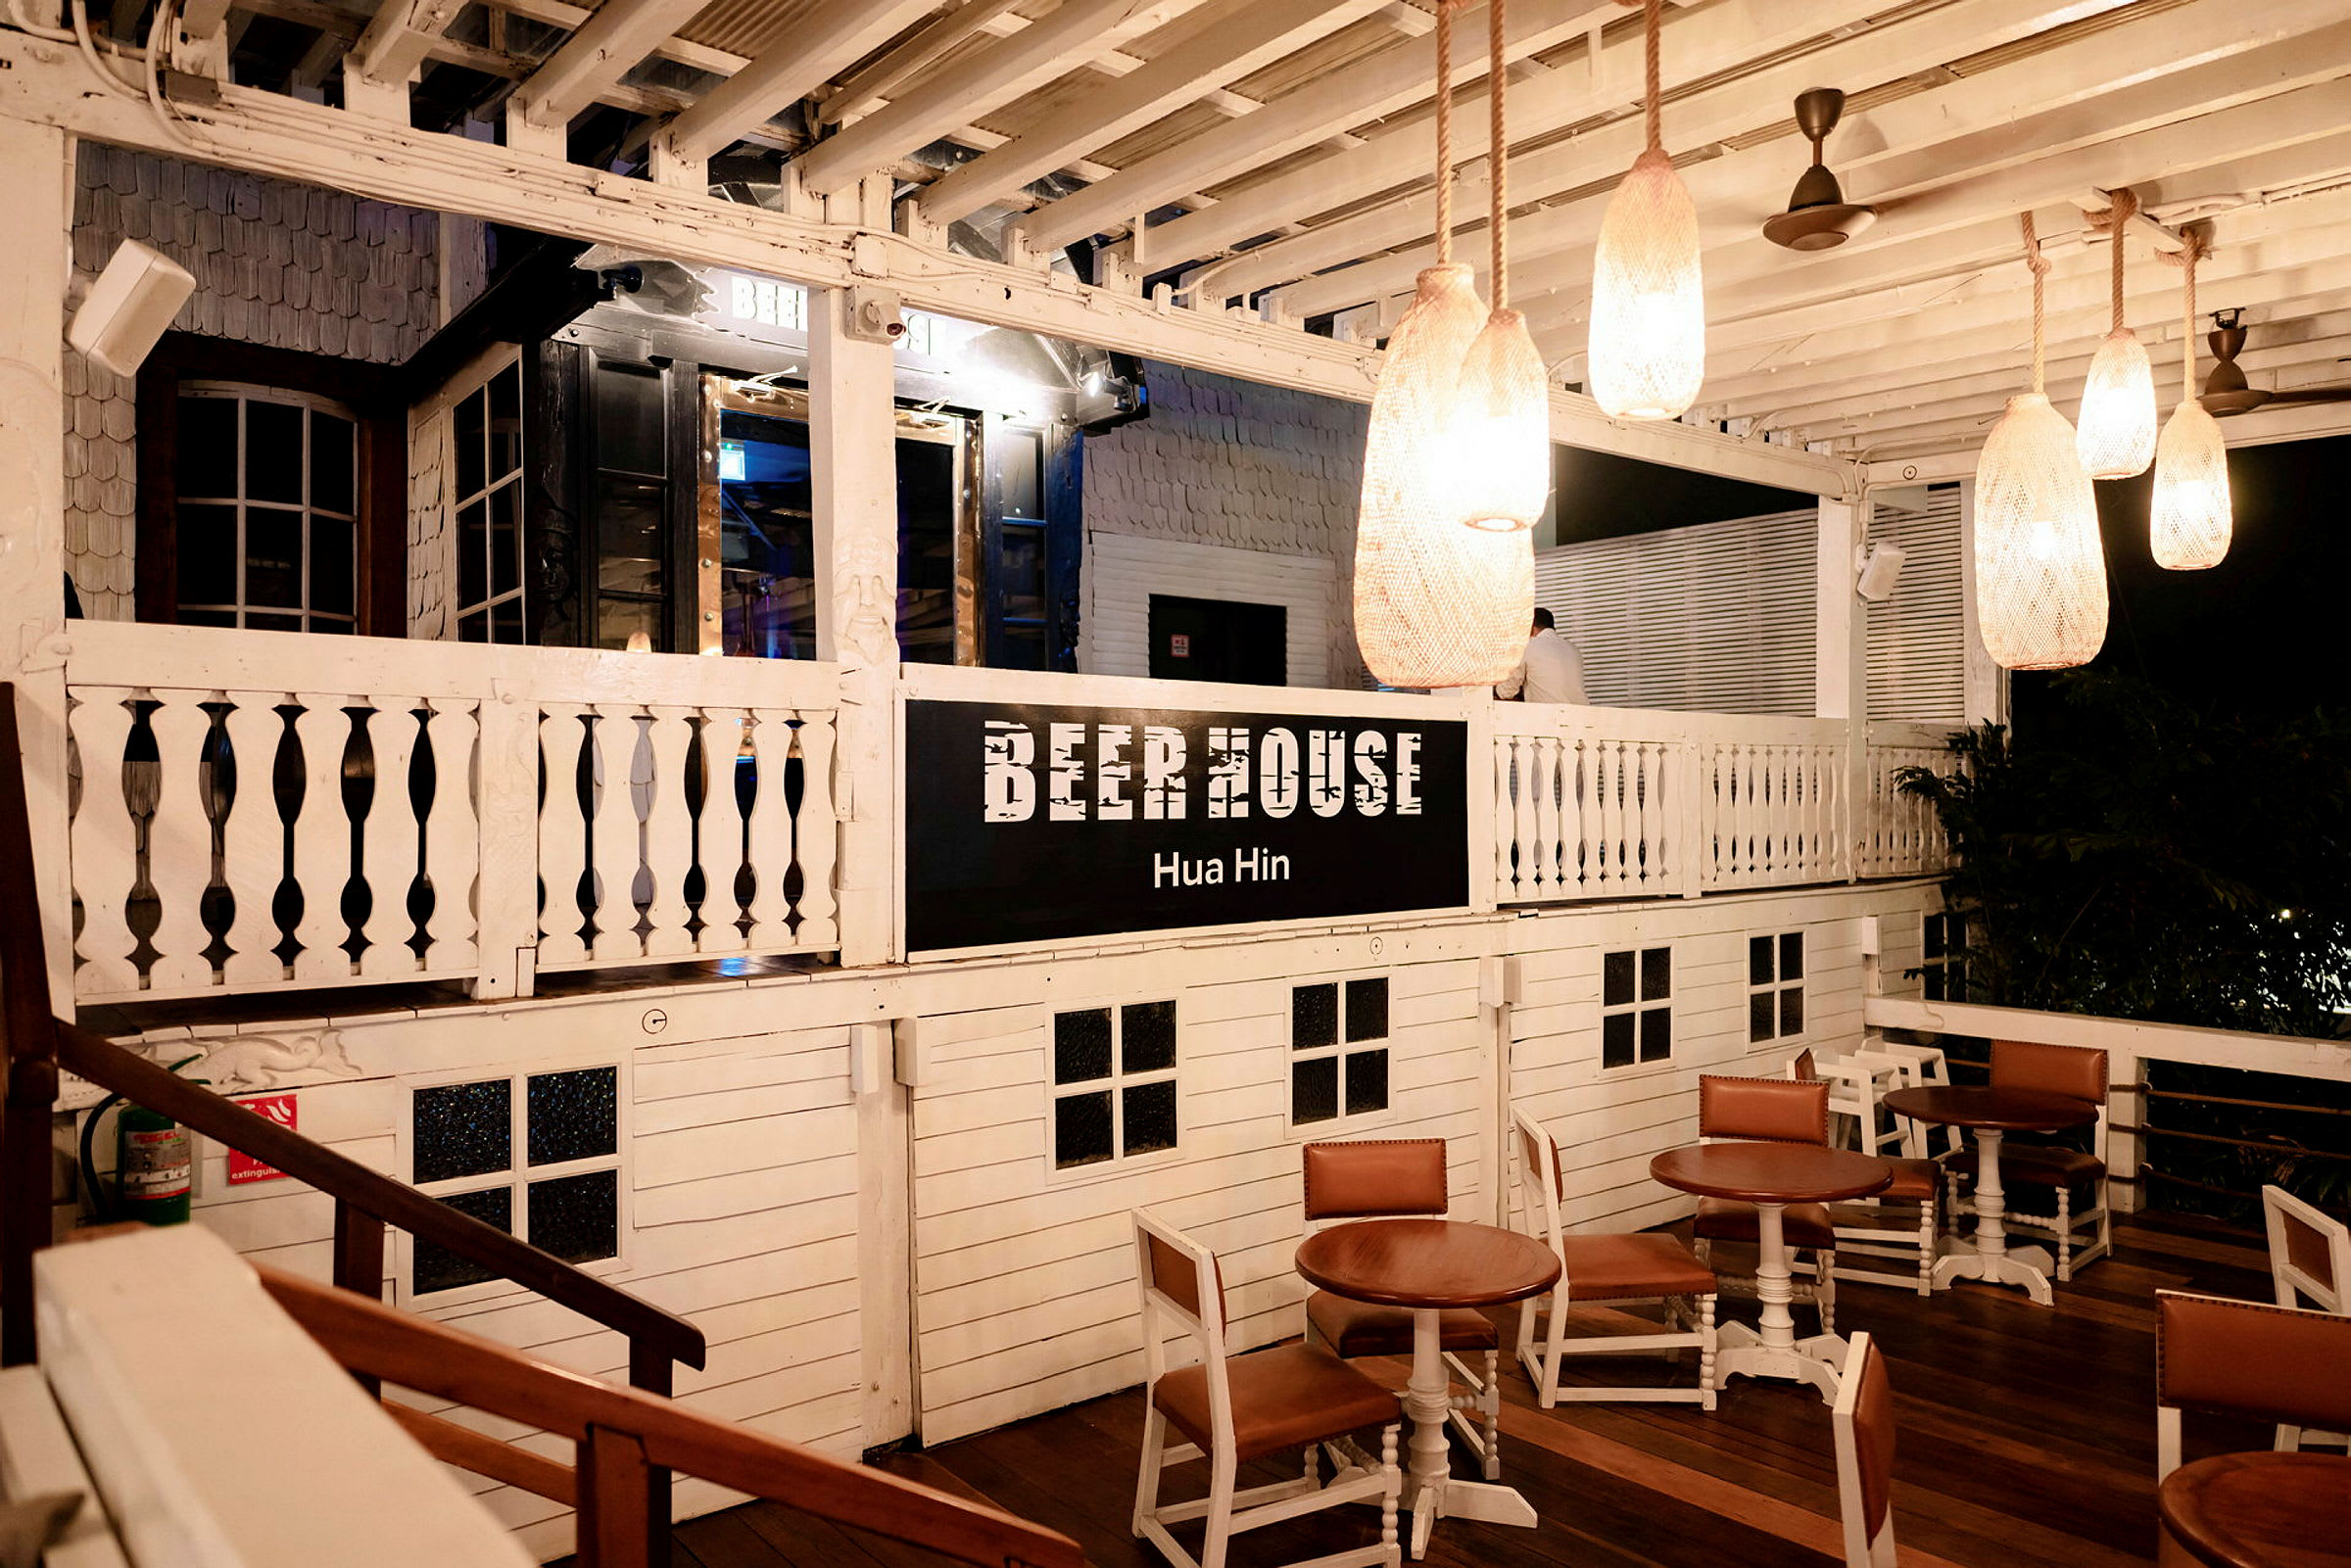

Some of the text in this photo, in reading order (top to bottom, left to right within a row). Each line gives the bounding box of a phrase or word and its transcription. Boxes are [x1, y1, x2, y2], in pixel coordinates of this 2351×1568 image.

[984, 720, 1422, 823] BEER HOUSE
[1154, 847, 1290, 888] Hua Hin
[231, 1166, 281, 1179] extinguis
